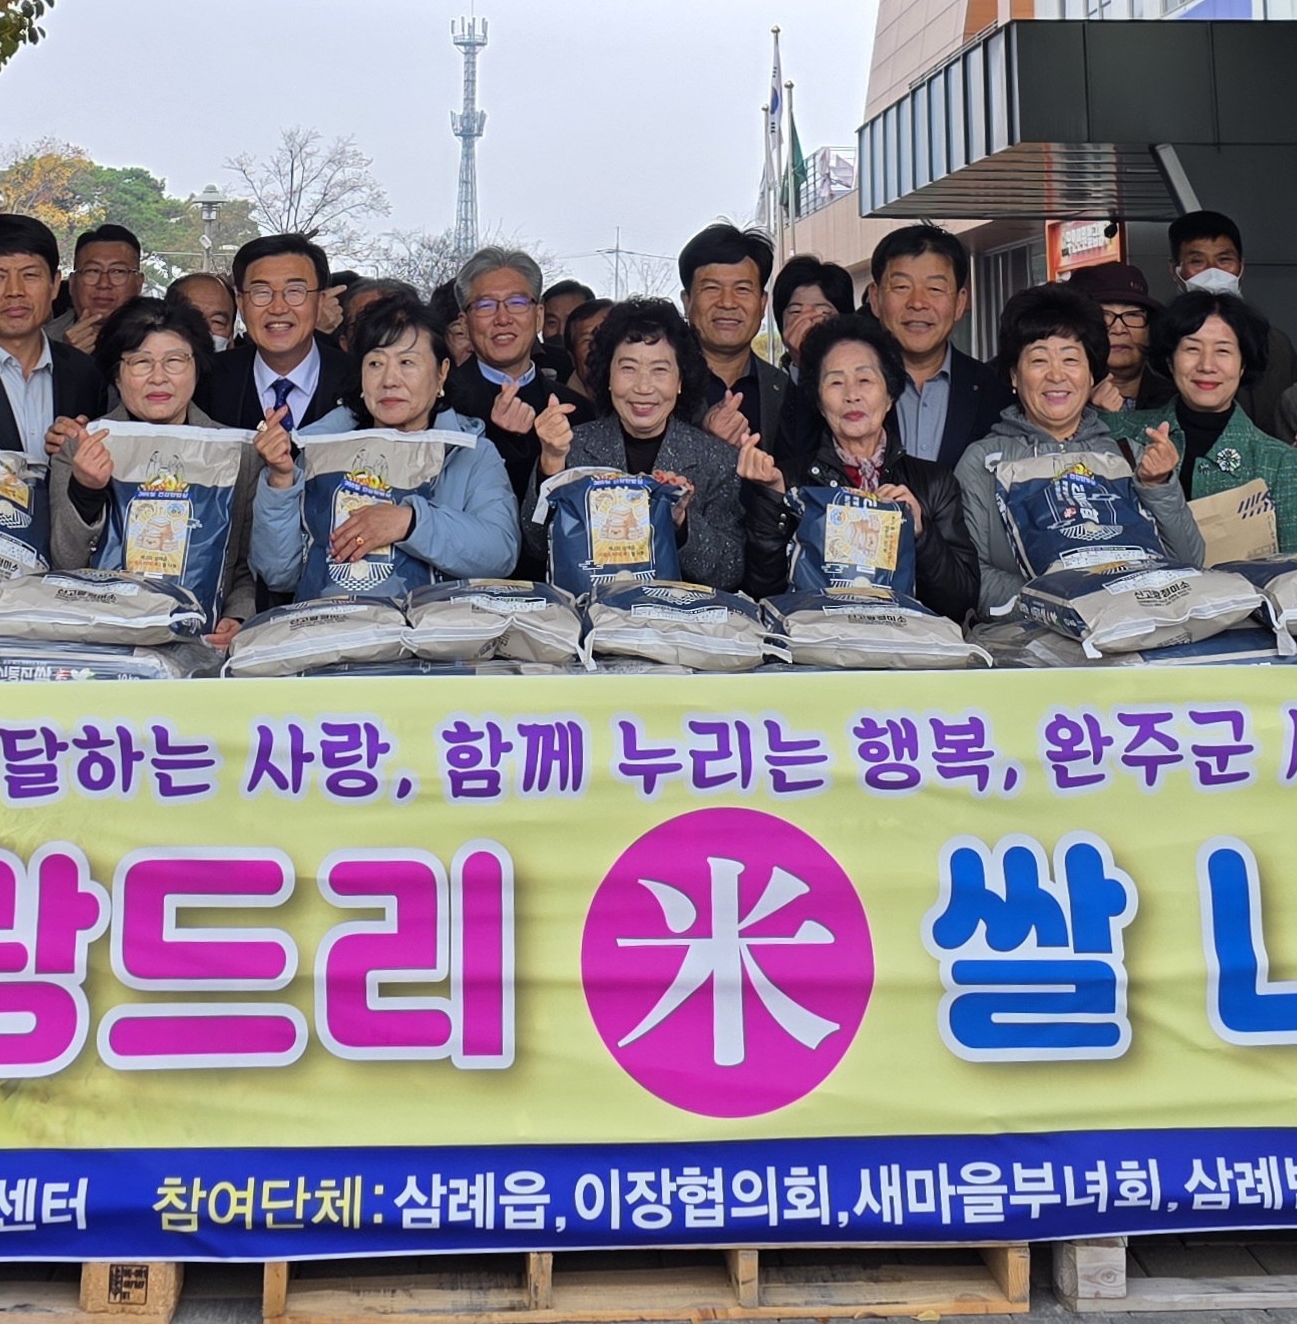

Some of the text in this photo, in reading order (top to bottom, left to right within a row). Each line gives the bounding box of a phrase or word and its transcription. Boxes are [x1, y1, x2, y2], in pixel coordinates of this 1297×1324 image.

[246, 721, 412, 799] 사랑,
[440, 719, 584, 798] 함께
[617, 718, 828, 795] 누리는
[852, 715, 1018, 792] 행복,
[1044, 709, 1254, 789] 완주군
[614, 854, 842, 1068] 米
[929, 840, 1130, 1051] 쌀
